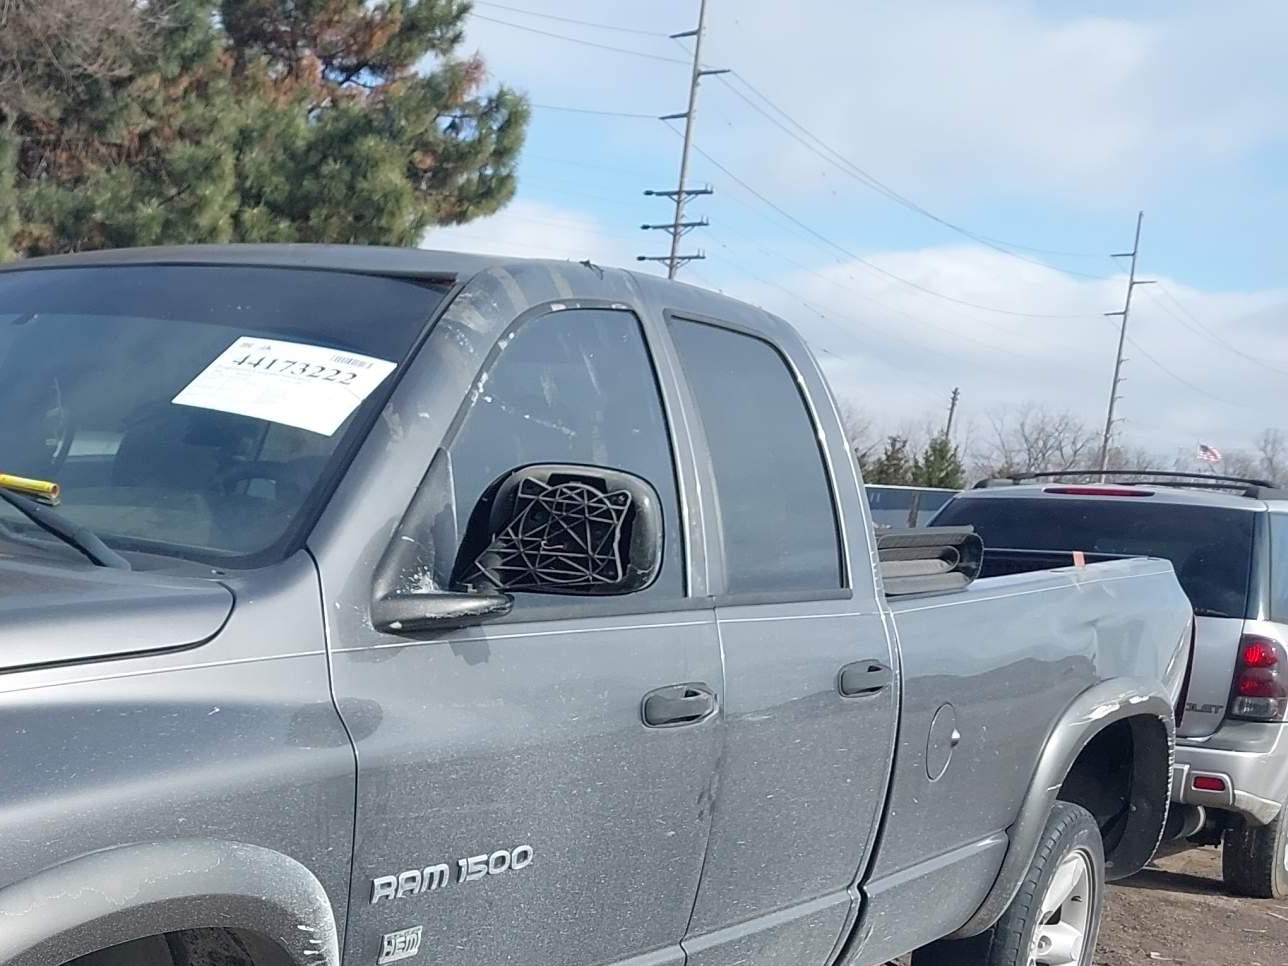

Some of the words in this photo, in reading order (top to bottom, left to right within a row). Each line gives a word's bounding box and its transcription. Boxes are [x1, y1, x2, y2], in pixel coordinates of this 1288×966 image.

[232, 355, 358, 385] 44173222
[370, 863, 450, 904] RAM
[457, 844, 534, 883] 1500
